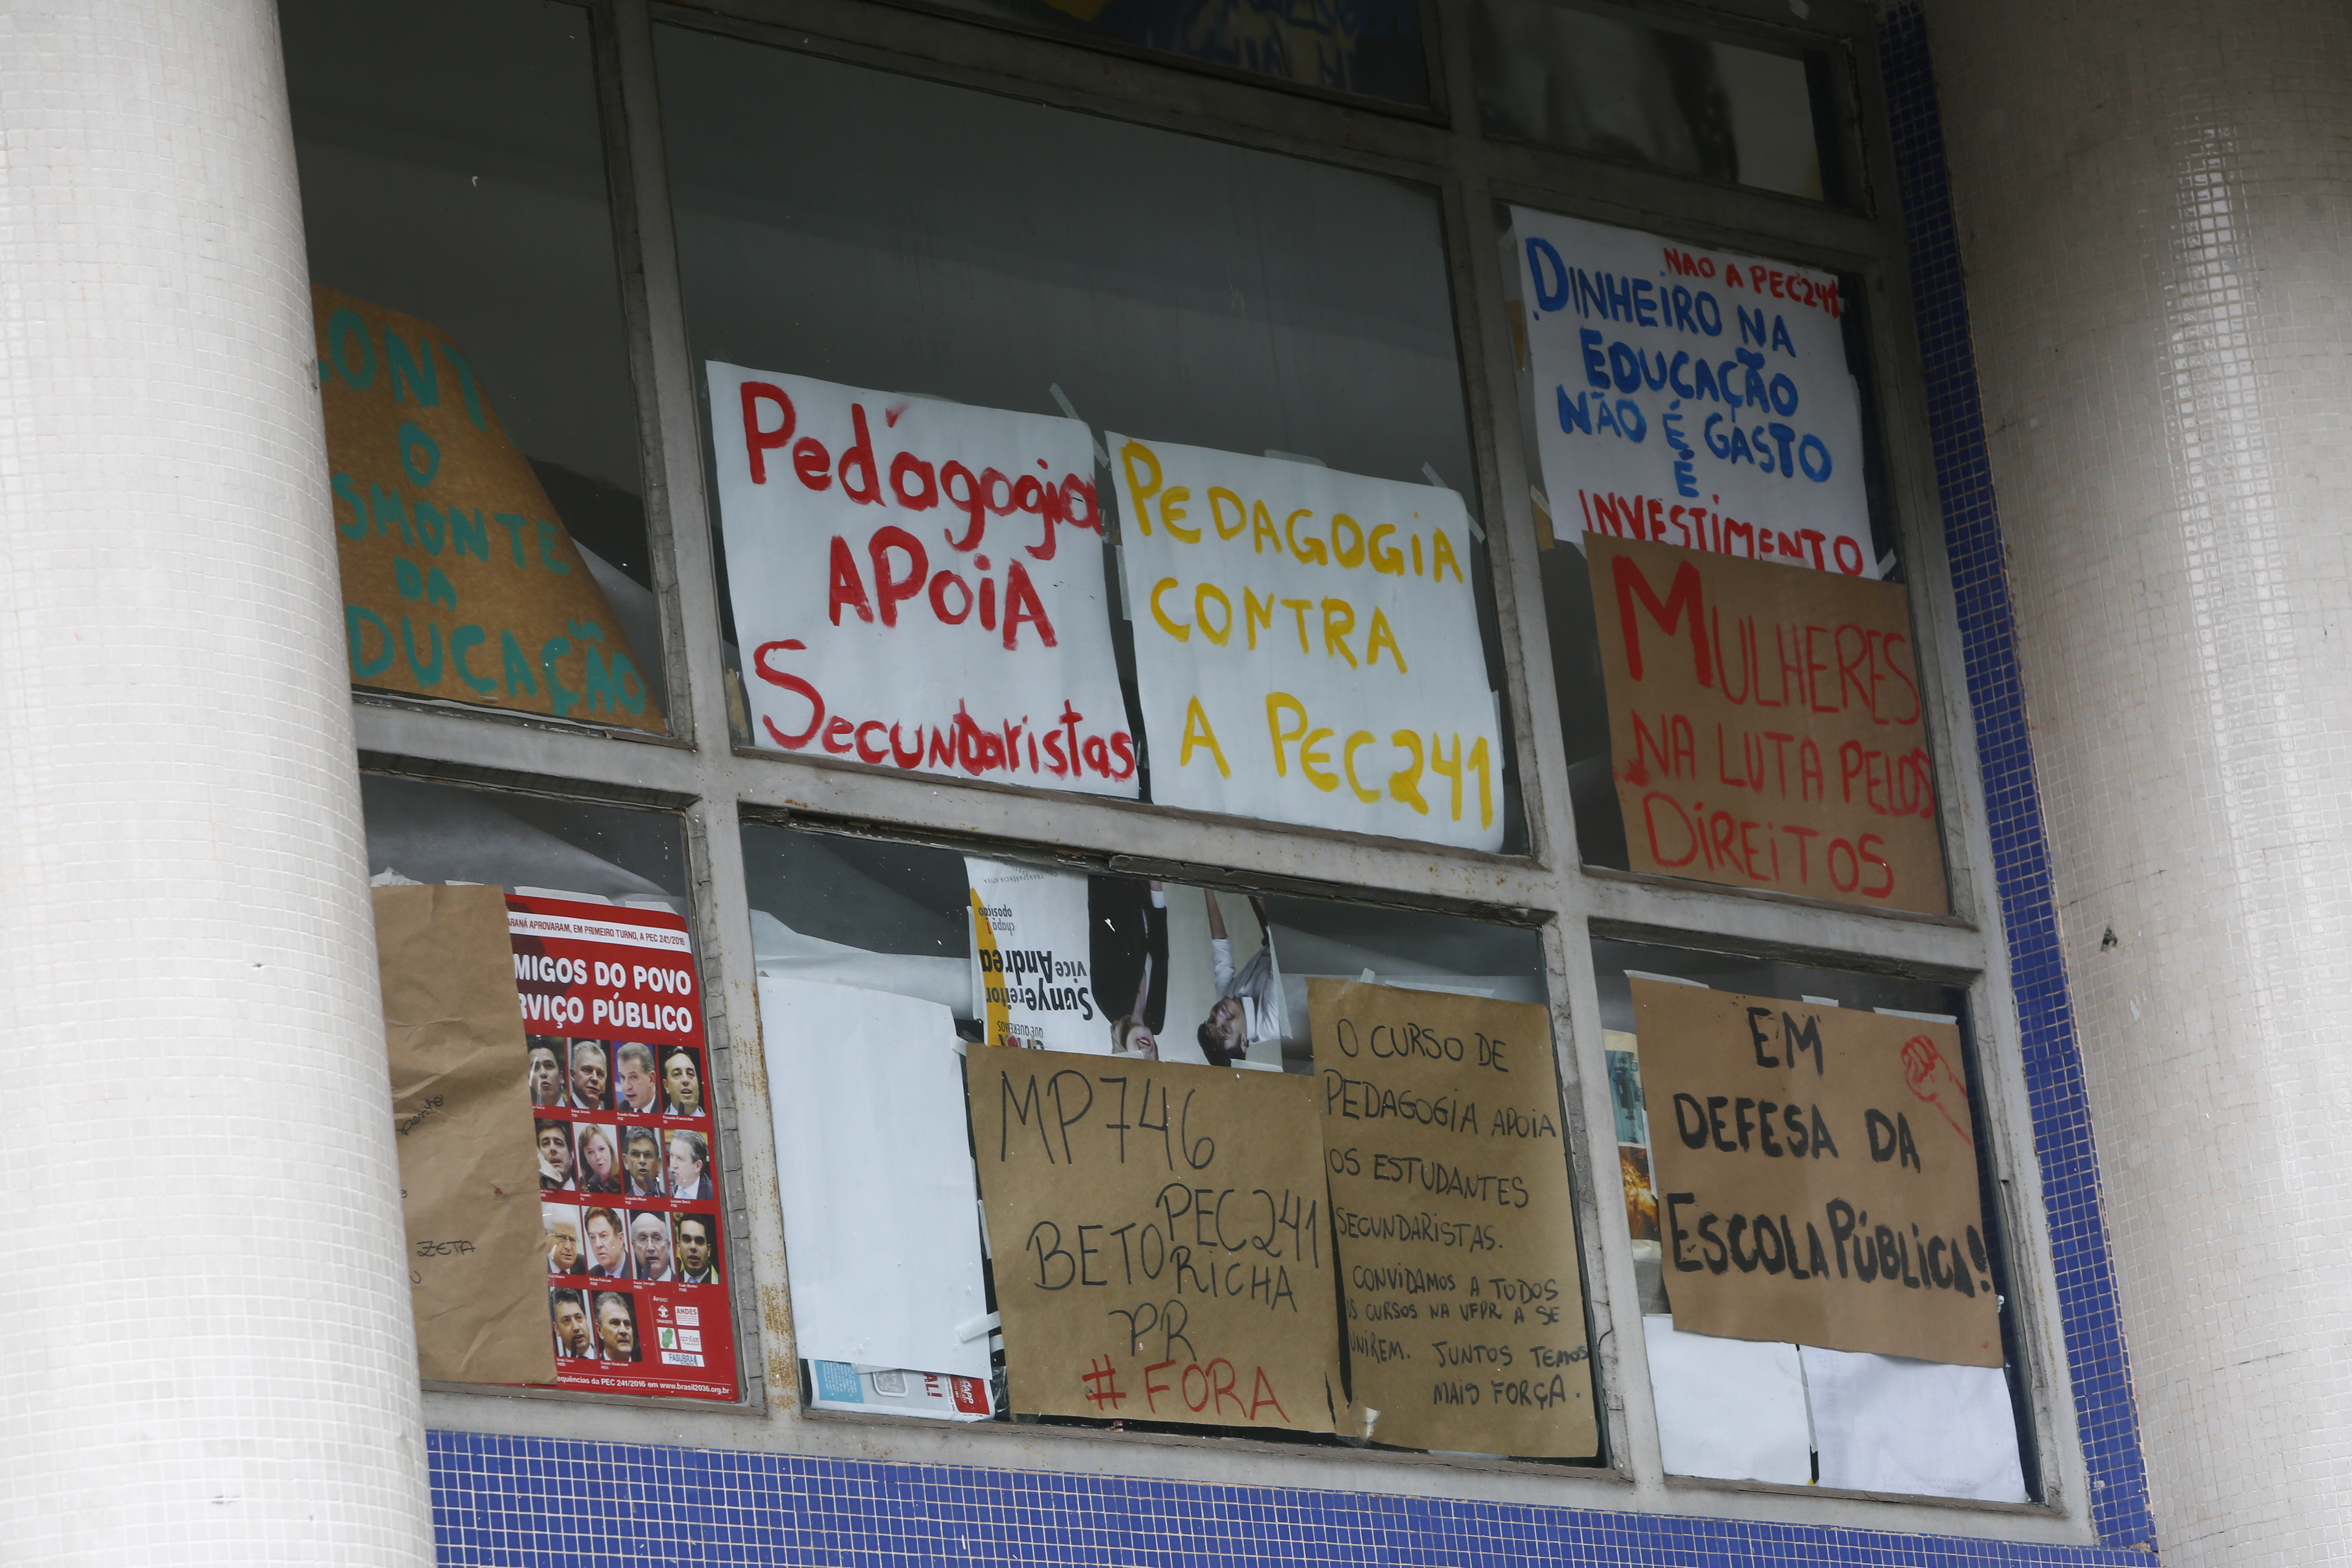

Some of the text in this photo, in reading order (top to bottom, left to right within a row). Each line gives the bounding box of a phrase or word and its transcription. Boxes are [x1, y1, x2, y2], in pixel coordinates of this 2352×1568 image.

[1726, 264, 1744, 288] A
[1737, 305, 1796, 358] NA
[320, 307, 517, 447] ONT
[1579, 327, 1798, 422] EDUCAÇÃO
[398, 421, 441, 488] O
[1556, 384, 1832, 483] NÃO É GASTO
[332, 473, 571, 575] SMONTE
[394, 555, 457, 612] DA
[1151, 577, 1408, 674] CONTRA
[1612, 554, 1922, 726] MULHERES
[1180, 695, 1231, 779] A
[1631, 708, 1935, 820] NA LUTA PELOS
[529, 920, 572, 934] APROVARAM,
[573, 924, 583, 934] EM
[584, 925, 615, 937] PRIMEIRO
[615, 929, 639, 941] TURNO,
[640, 932, 645, 941] A
[645, 933, 658, 942] PEC
[978, 904, 1013, 920] oposição
[986, 918, 1015, 936] chapa 1
[512, 953, 692, 996] MIGOS DO POVO
[979, 949, 1087, 986] vice Andrea
[518, 992, 693, 1033] RVIÇO PÚBLICO
[998, 1020, 1043, 1038] QUE QUEREMOS
[1337, 1018, 1509, 1073] O CURSO DE
[1745, 1007, 1824, 1076] EM
[1323, 1069, 1478, 1136] PEDAGOGIA
[1673, 1092, 1920, 1173] DEFESA DA
[1329, 1148, 1529, 1208] OS ESTUDANTES
[1335, 1206, 1503, 1252] SECUNDARISTAS.
[1666, 1192, 1830, 1281] ESCOLA
[1025, 1221, 1298, 1313] BETO RICHA
[1352, 1262, 1559, 1304] CONVIDAMOS A TODOS
[1108, 1299, 1198, 1362] PR
[1365, 1301, 1418, 1322] CURSOS
[1430, 1303, 1450, 1319] NA
[1459, 1301, 1502, 1322] UFPR
[1514, 1306, 1525, 1325] A
[1535, 1305, 1560, 1326] SE
[669, 1353, 694, 1363] FASUBRA
[1431, 1341, 1513, 1369] JUNTOS
[1529, 1345, 1589, 1368] TEMOS
[557, 1375, 590, 1384] equências
[601, 1378, 615, 1386] PEC
[659, 1382, 730, 1395] www.brasil2036.org.br
